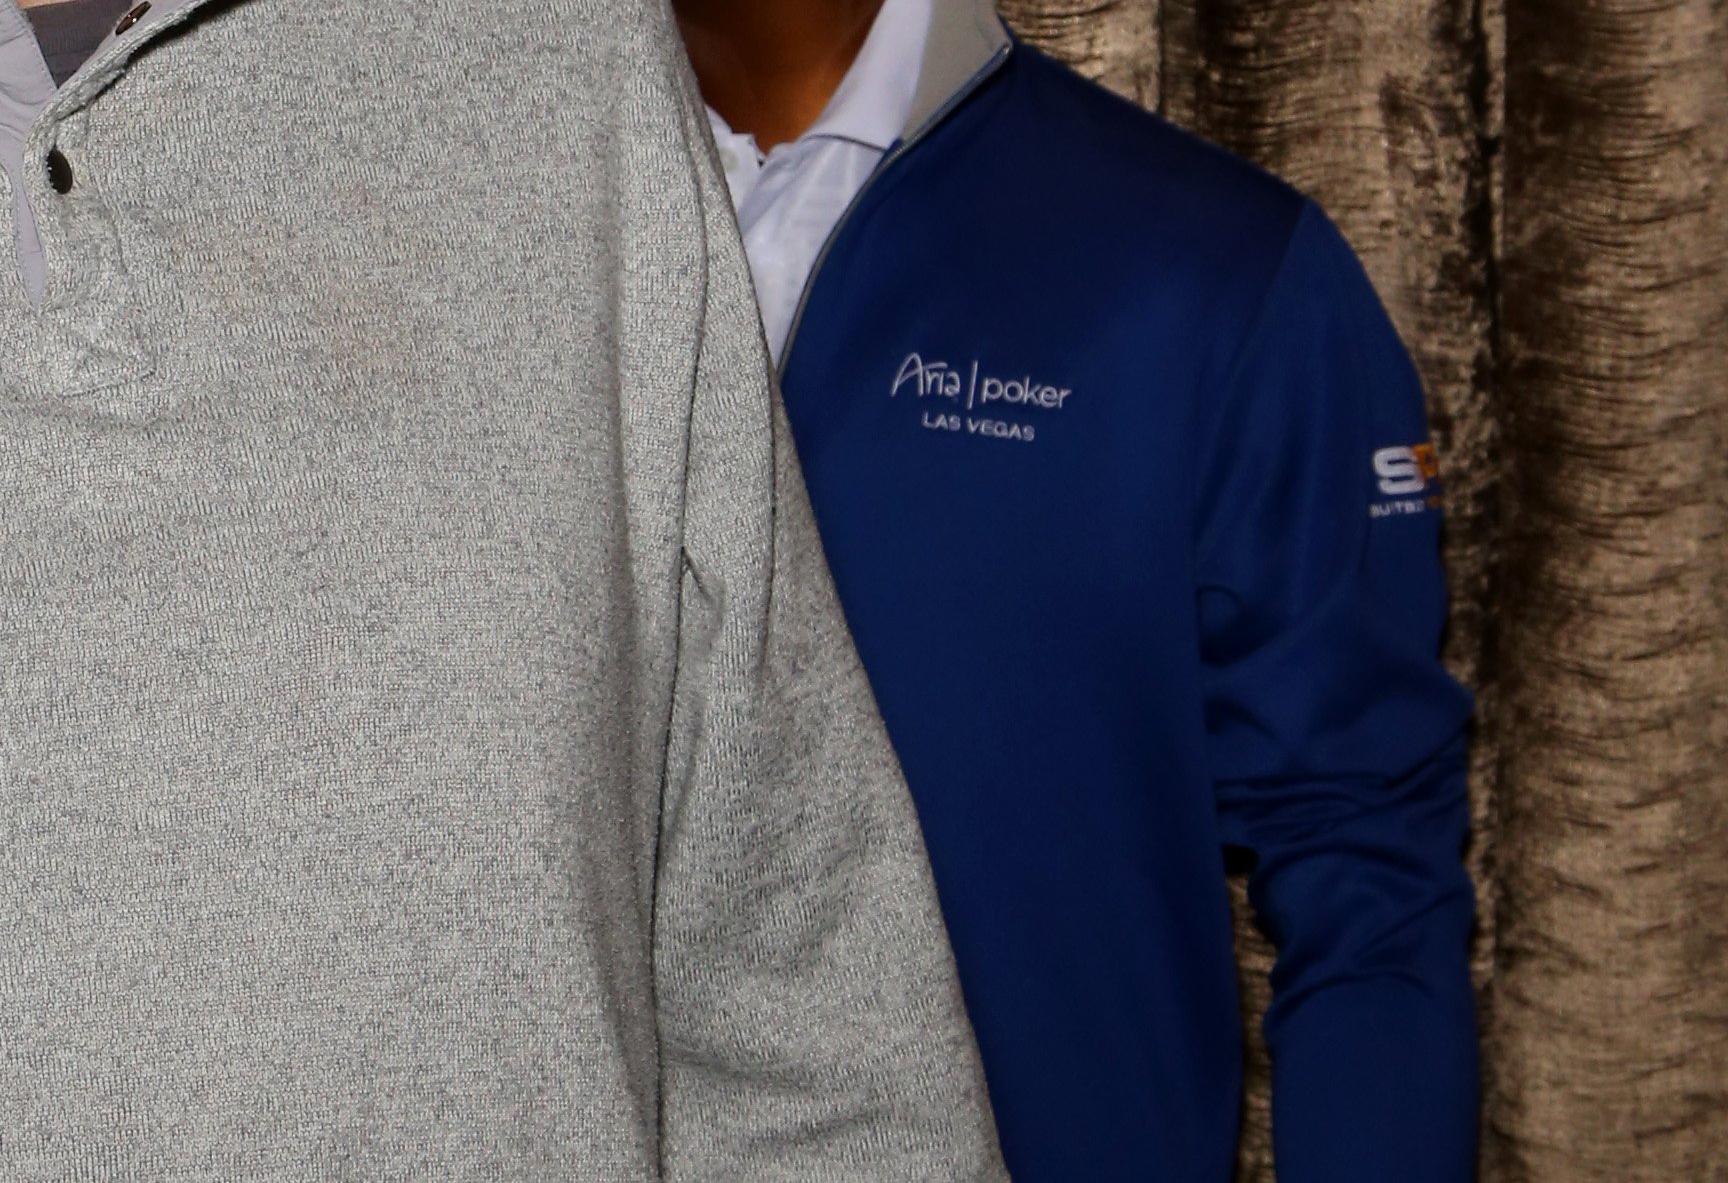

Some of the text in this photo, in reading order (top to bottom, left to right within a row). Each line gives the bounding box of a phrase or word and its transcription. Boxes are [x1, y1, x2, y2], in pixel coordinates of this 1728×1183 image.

[889, 351, 1072, 410] Aria poker
[921, 410, 1036, 442] LAS VEGAS
